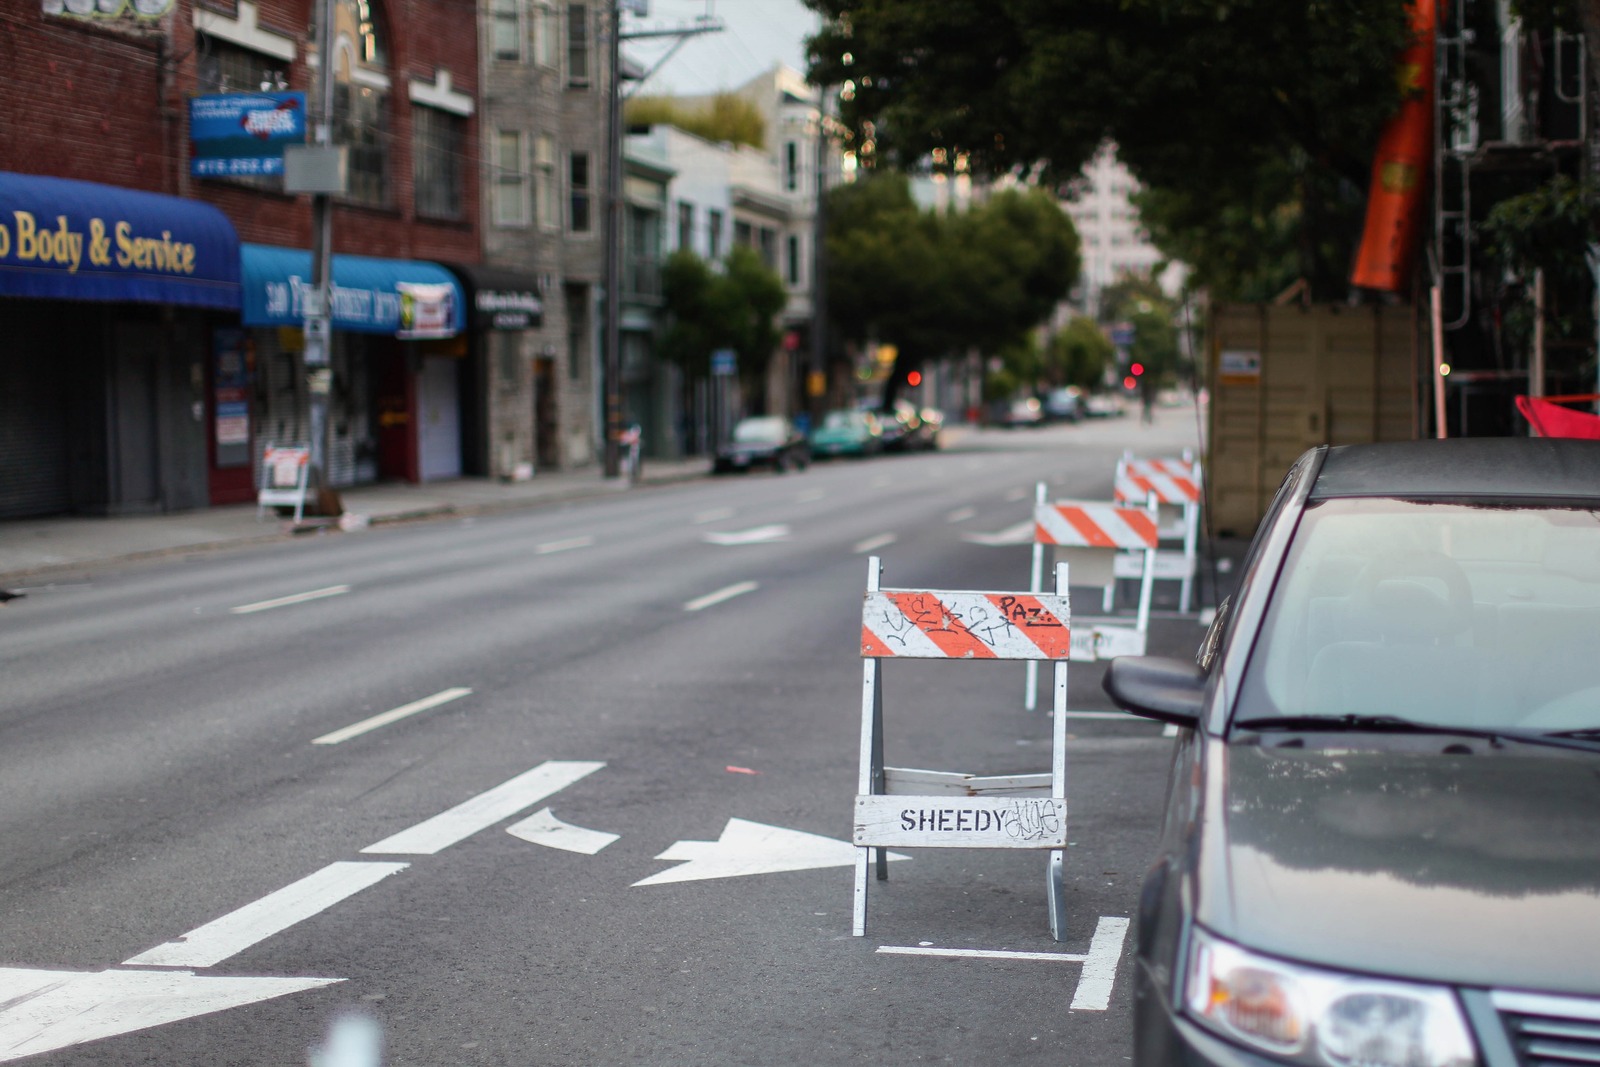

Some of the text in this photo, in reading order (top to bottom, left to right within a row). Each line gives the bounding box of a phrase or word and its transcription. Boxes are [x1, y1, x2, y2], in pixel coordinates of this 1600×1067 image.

[13, 211, 83, 274] Body
[89, 218, 111, 265] &
[115, 221, 195, 274] Service
[901, 809, 1006, 832] SHEEDY
